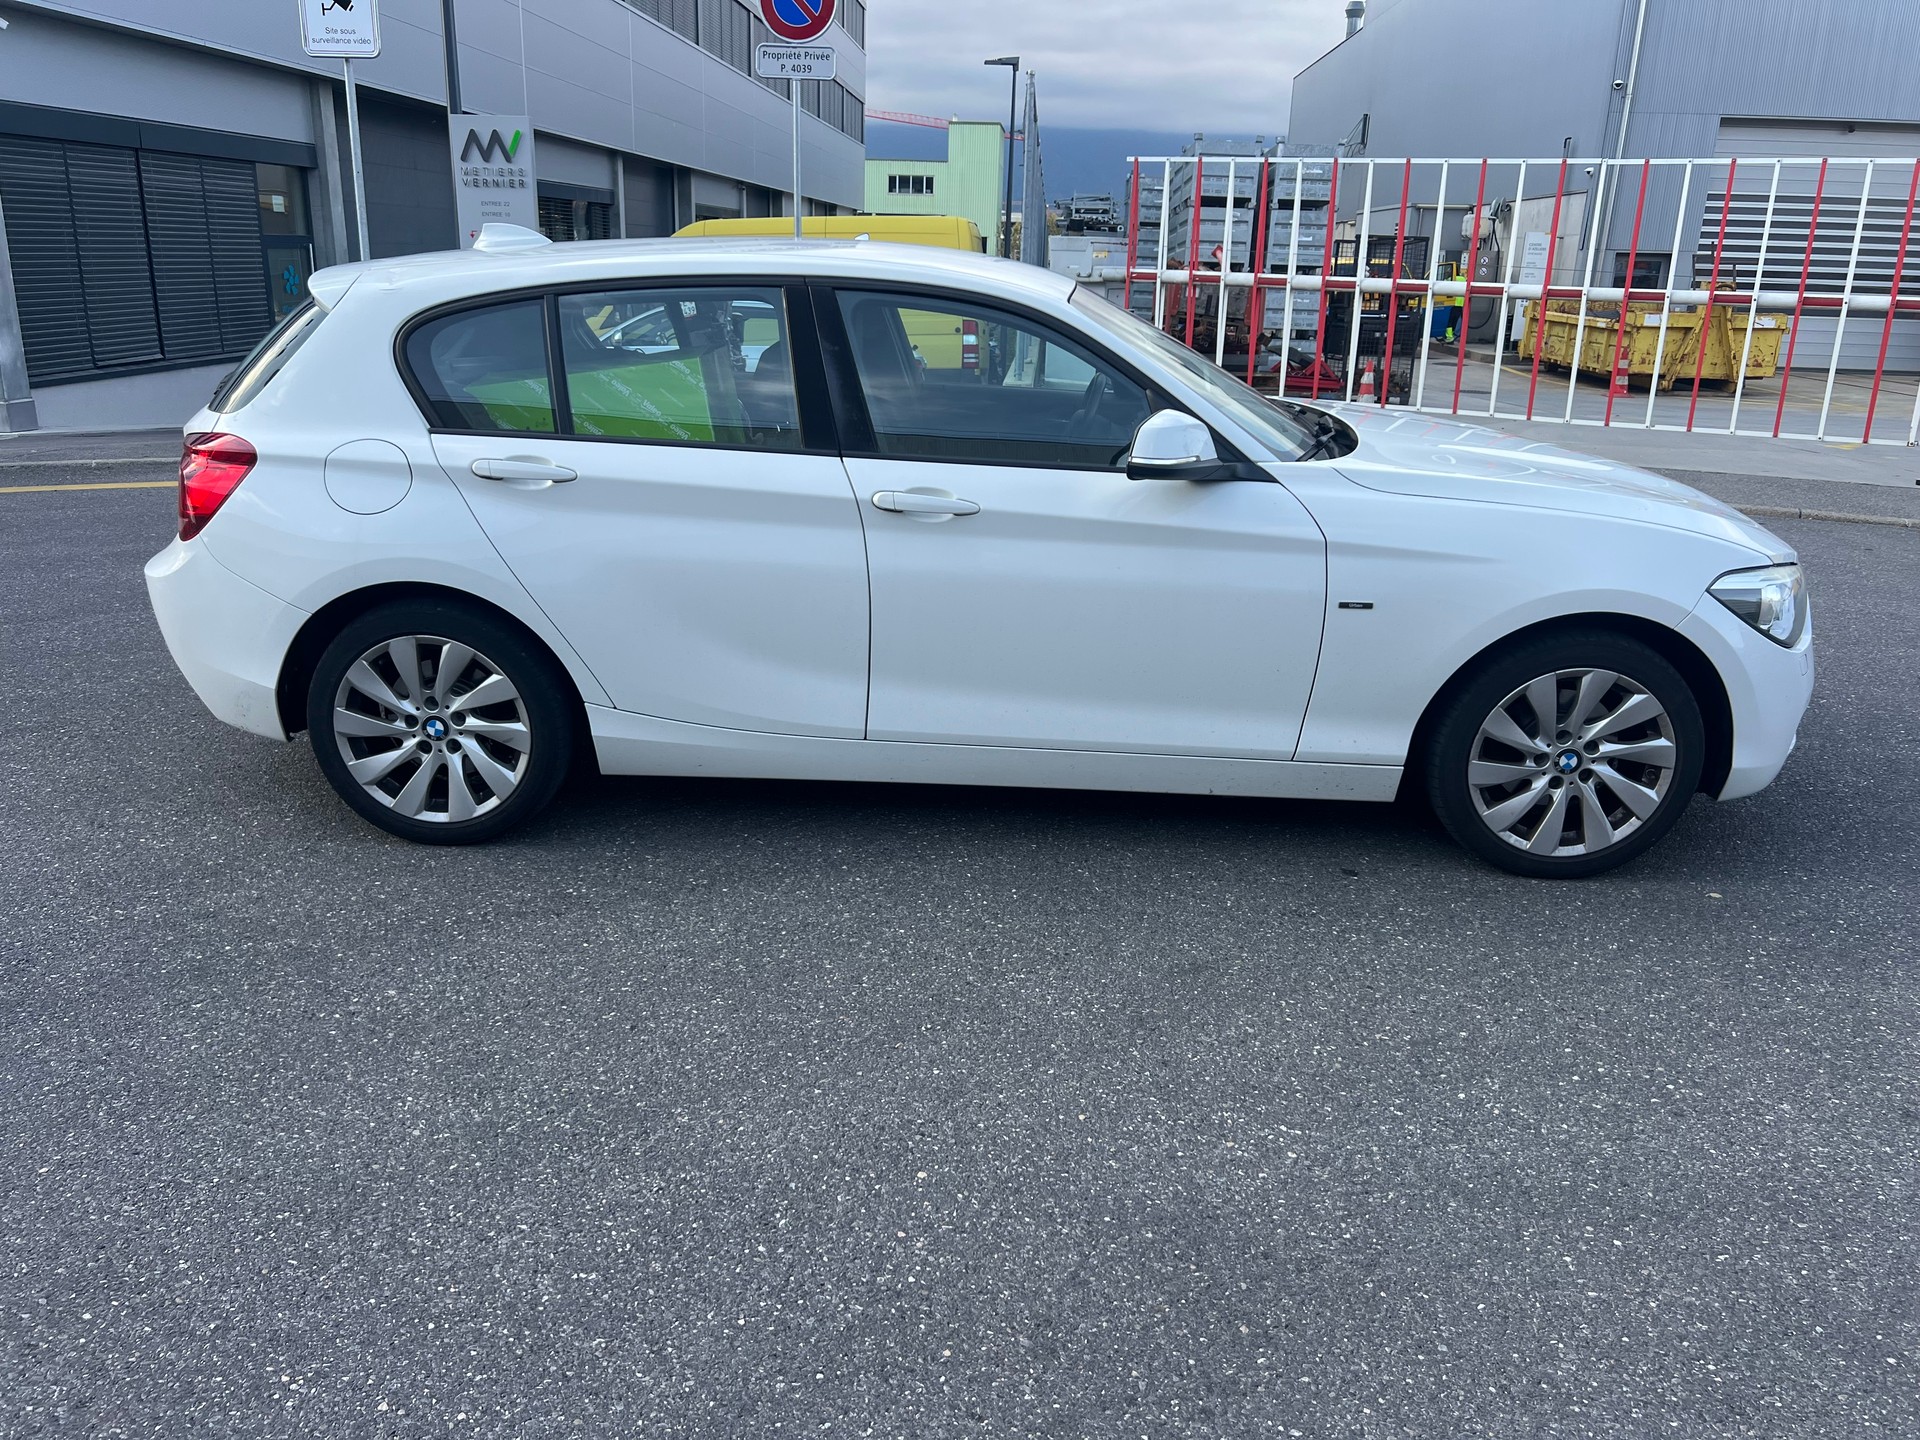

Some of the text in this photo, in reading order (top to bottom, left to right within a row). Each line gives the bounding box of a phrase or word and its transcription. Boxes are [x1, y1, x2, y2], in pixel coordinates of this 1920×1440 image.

[325, 27, 339, 35] Site
[762, 50, 831, 61] Propriété Privée
[780, 63, 812, 73] P. 4039
[460, 167, 526, 177] METIERS
[462, 178, 527, 189] VERNIER
